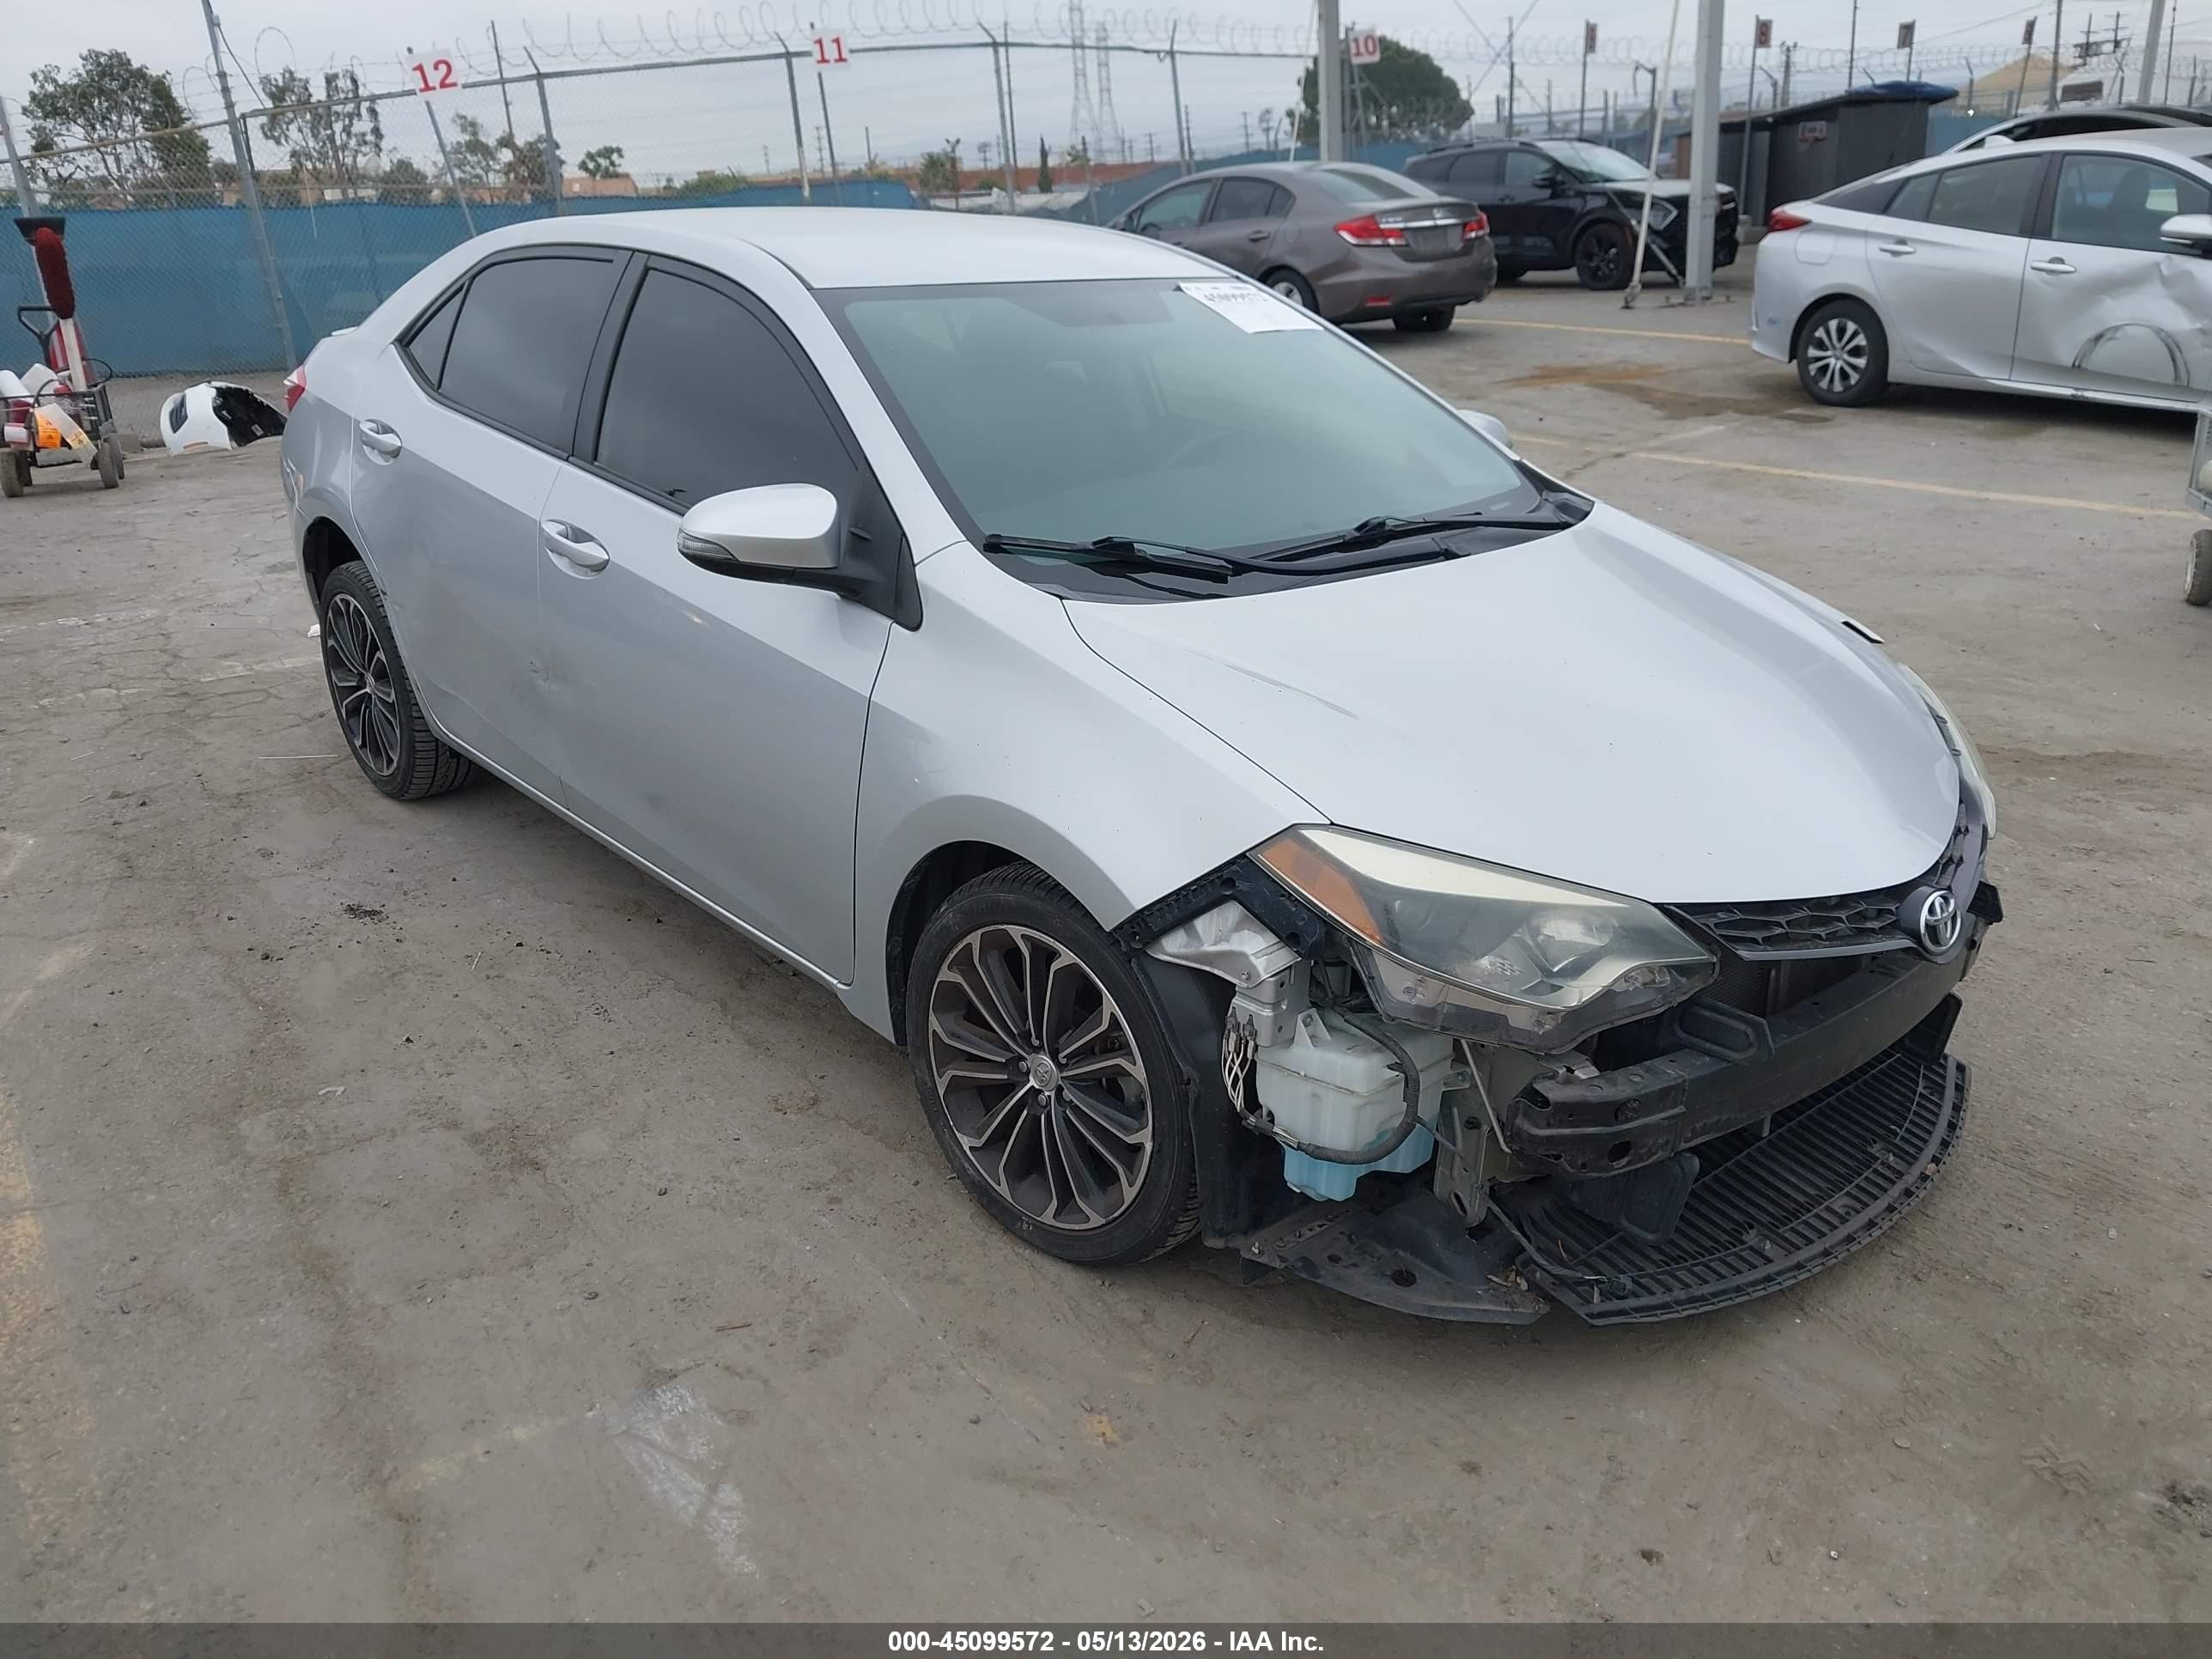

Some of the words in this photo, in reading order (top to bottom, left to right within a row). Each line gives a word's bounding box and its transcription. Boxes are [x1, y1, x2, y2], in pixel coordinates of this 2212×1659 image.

[813, 36, 848, 64] 11
[1352, 34, 1376, 57] 10
[412, 58, 458, 93] 12
